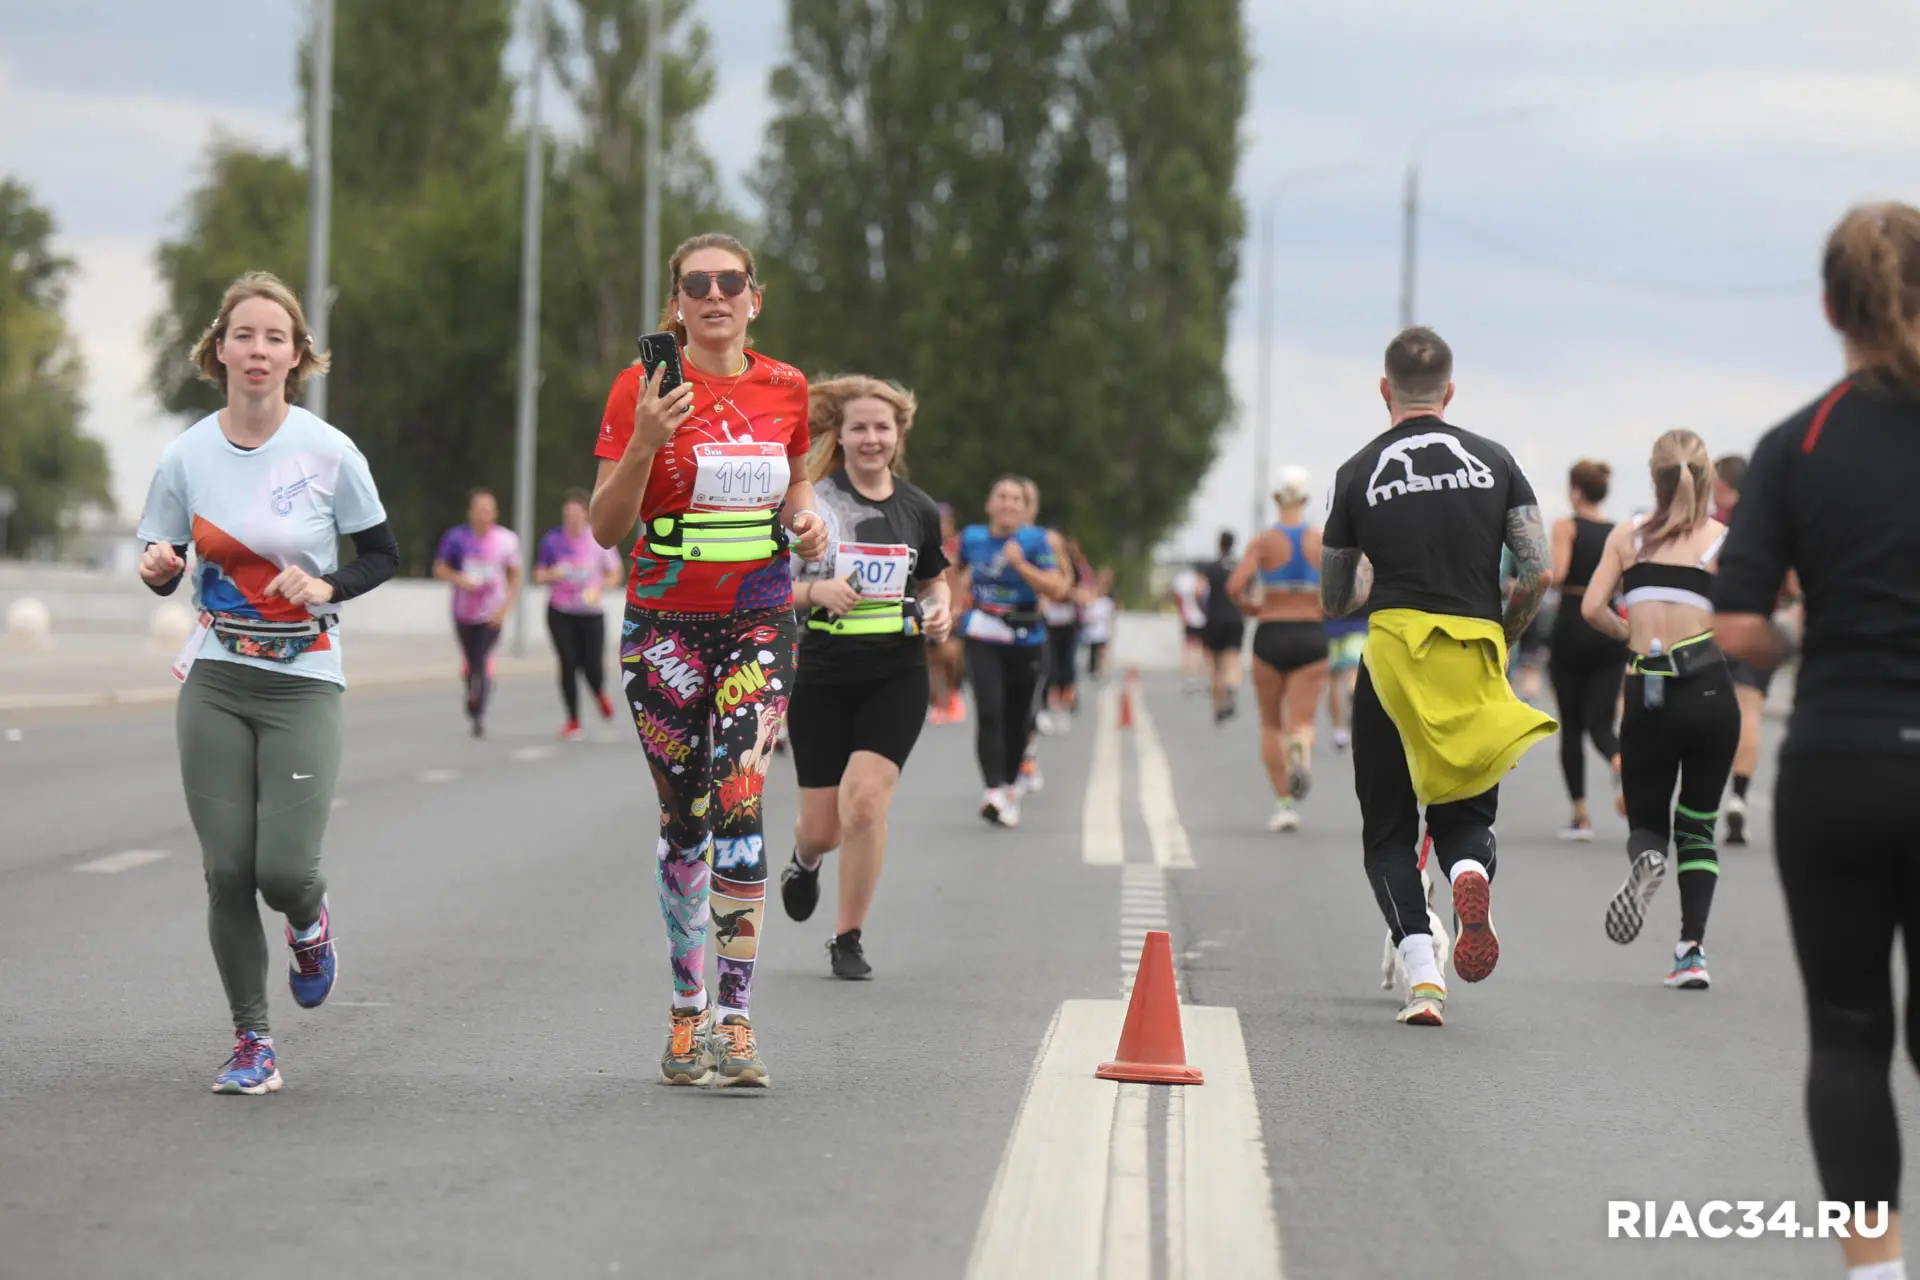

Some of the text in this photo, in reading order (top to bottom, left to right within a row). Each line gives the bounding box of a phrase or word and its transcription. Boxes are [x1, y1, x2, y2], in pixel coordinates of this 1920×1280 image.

[715, 461, 771, 494] 111
[1366, 467, 1495, 507] manto
[642, 638, 705, 700] BANG
[715, 659, 767, 718] POW
[637, 712, 691, 763] SUPER
[715, 834, 763, 869] ZAP
